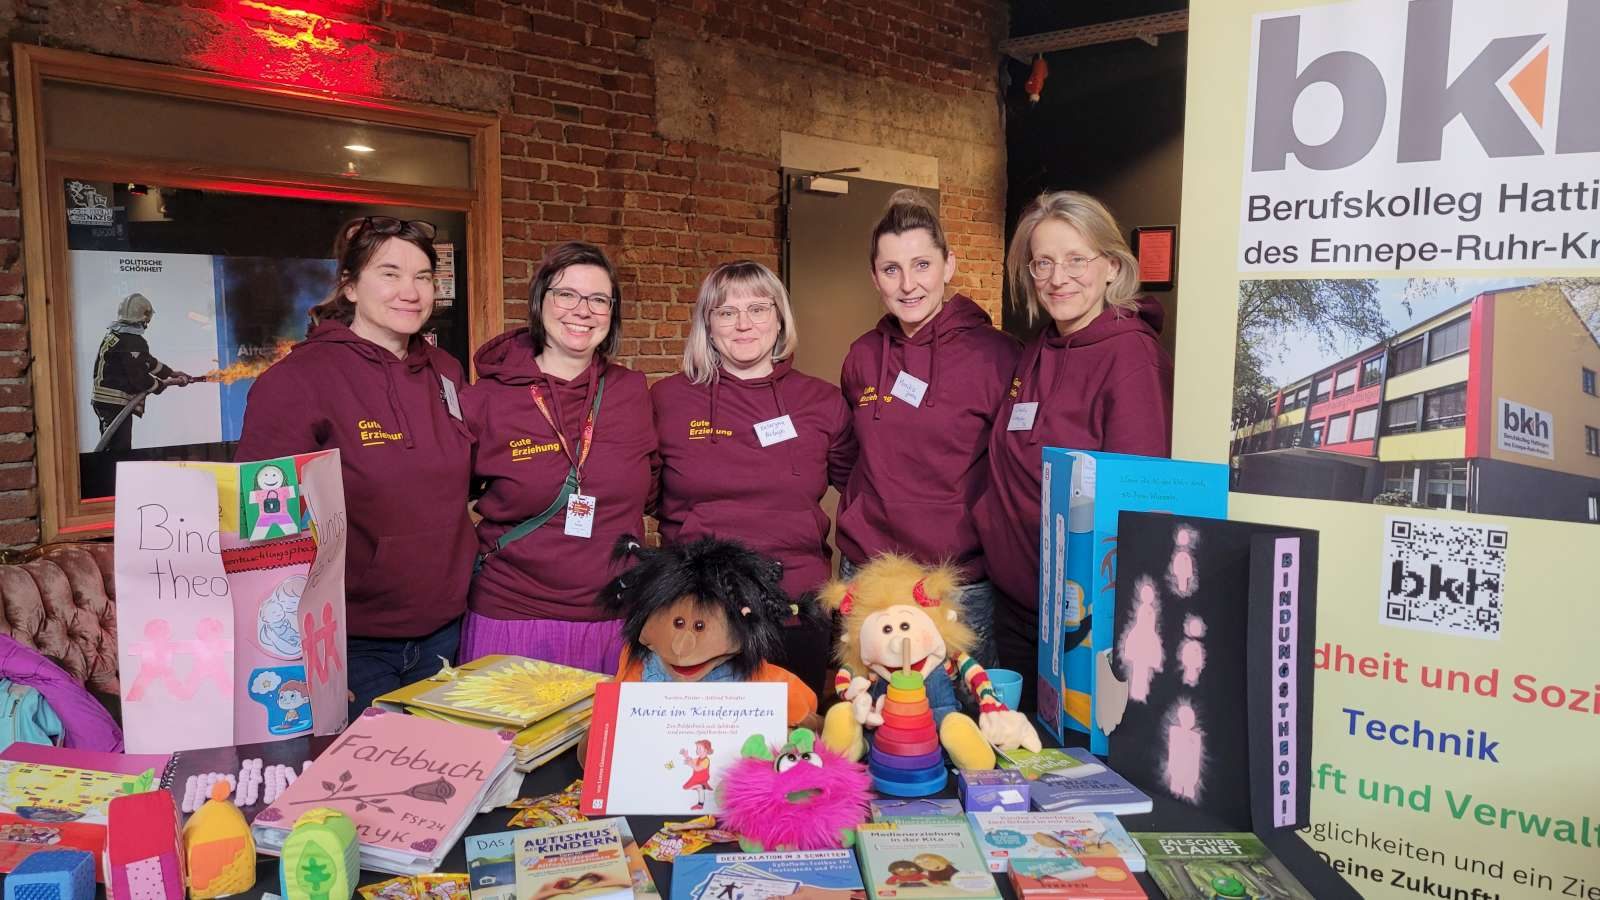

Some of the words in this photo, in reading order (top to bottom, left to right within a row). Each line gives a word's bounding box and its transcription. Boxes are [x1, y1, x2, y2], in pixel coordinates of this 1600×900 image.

[1248, 187, 1482, 222] Berufskolleg
[1499, 179, 1600, 213] Hatti
[1244, 241, 1299, 264] des
[1311, 232, 1600, 269] Ennepe-Ruhr-Kr
[120, 265, 162, 273] SCHÖNHEIT
[1504, 403, 1549, 440] bkh
[509, 438, 532, 448] Gute
[512, 442, 560, 457] Erziehung
[149, 559, 229, 599] theo
[1421, 665, 1500, 698] und
[1512, 674, 1600, 715] Sozi
[630, 706, 667, 718] Marie
[671, 706, 686, 718] im
[690, 705, 775, 721] Kindergarten
[1342, 707, 1500, 763] Technik
[330, 734, 487, 782] Farbbuch
[1311, 763, 1347, 795] ft
[1358, 778, 1431, 813] und
[477, 839, 505, 850] DAS
[524, 828, 611, 847] AUTISMUS
[538, 836, 618, 853] KINDERN
[1158, 839, 1237, 847] FALSCHER
[1162, 845, 1244, 855] PLANET
[1315, 850, 1384, 883] Deine
[1390, 868, 1500, 900] Zukunft
[1455, 855, 1504, 880] und
[1513, 867, 1552, 891] ein
